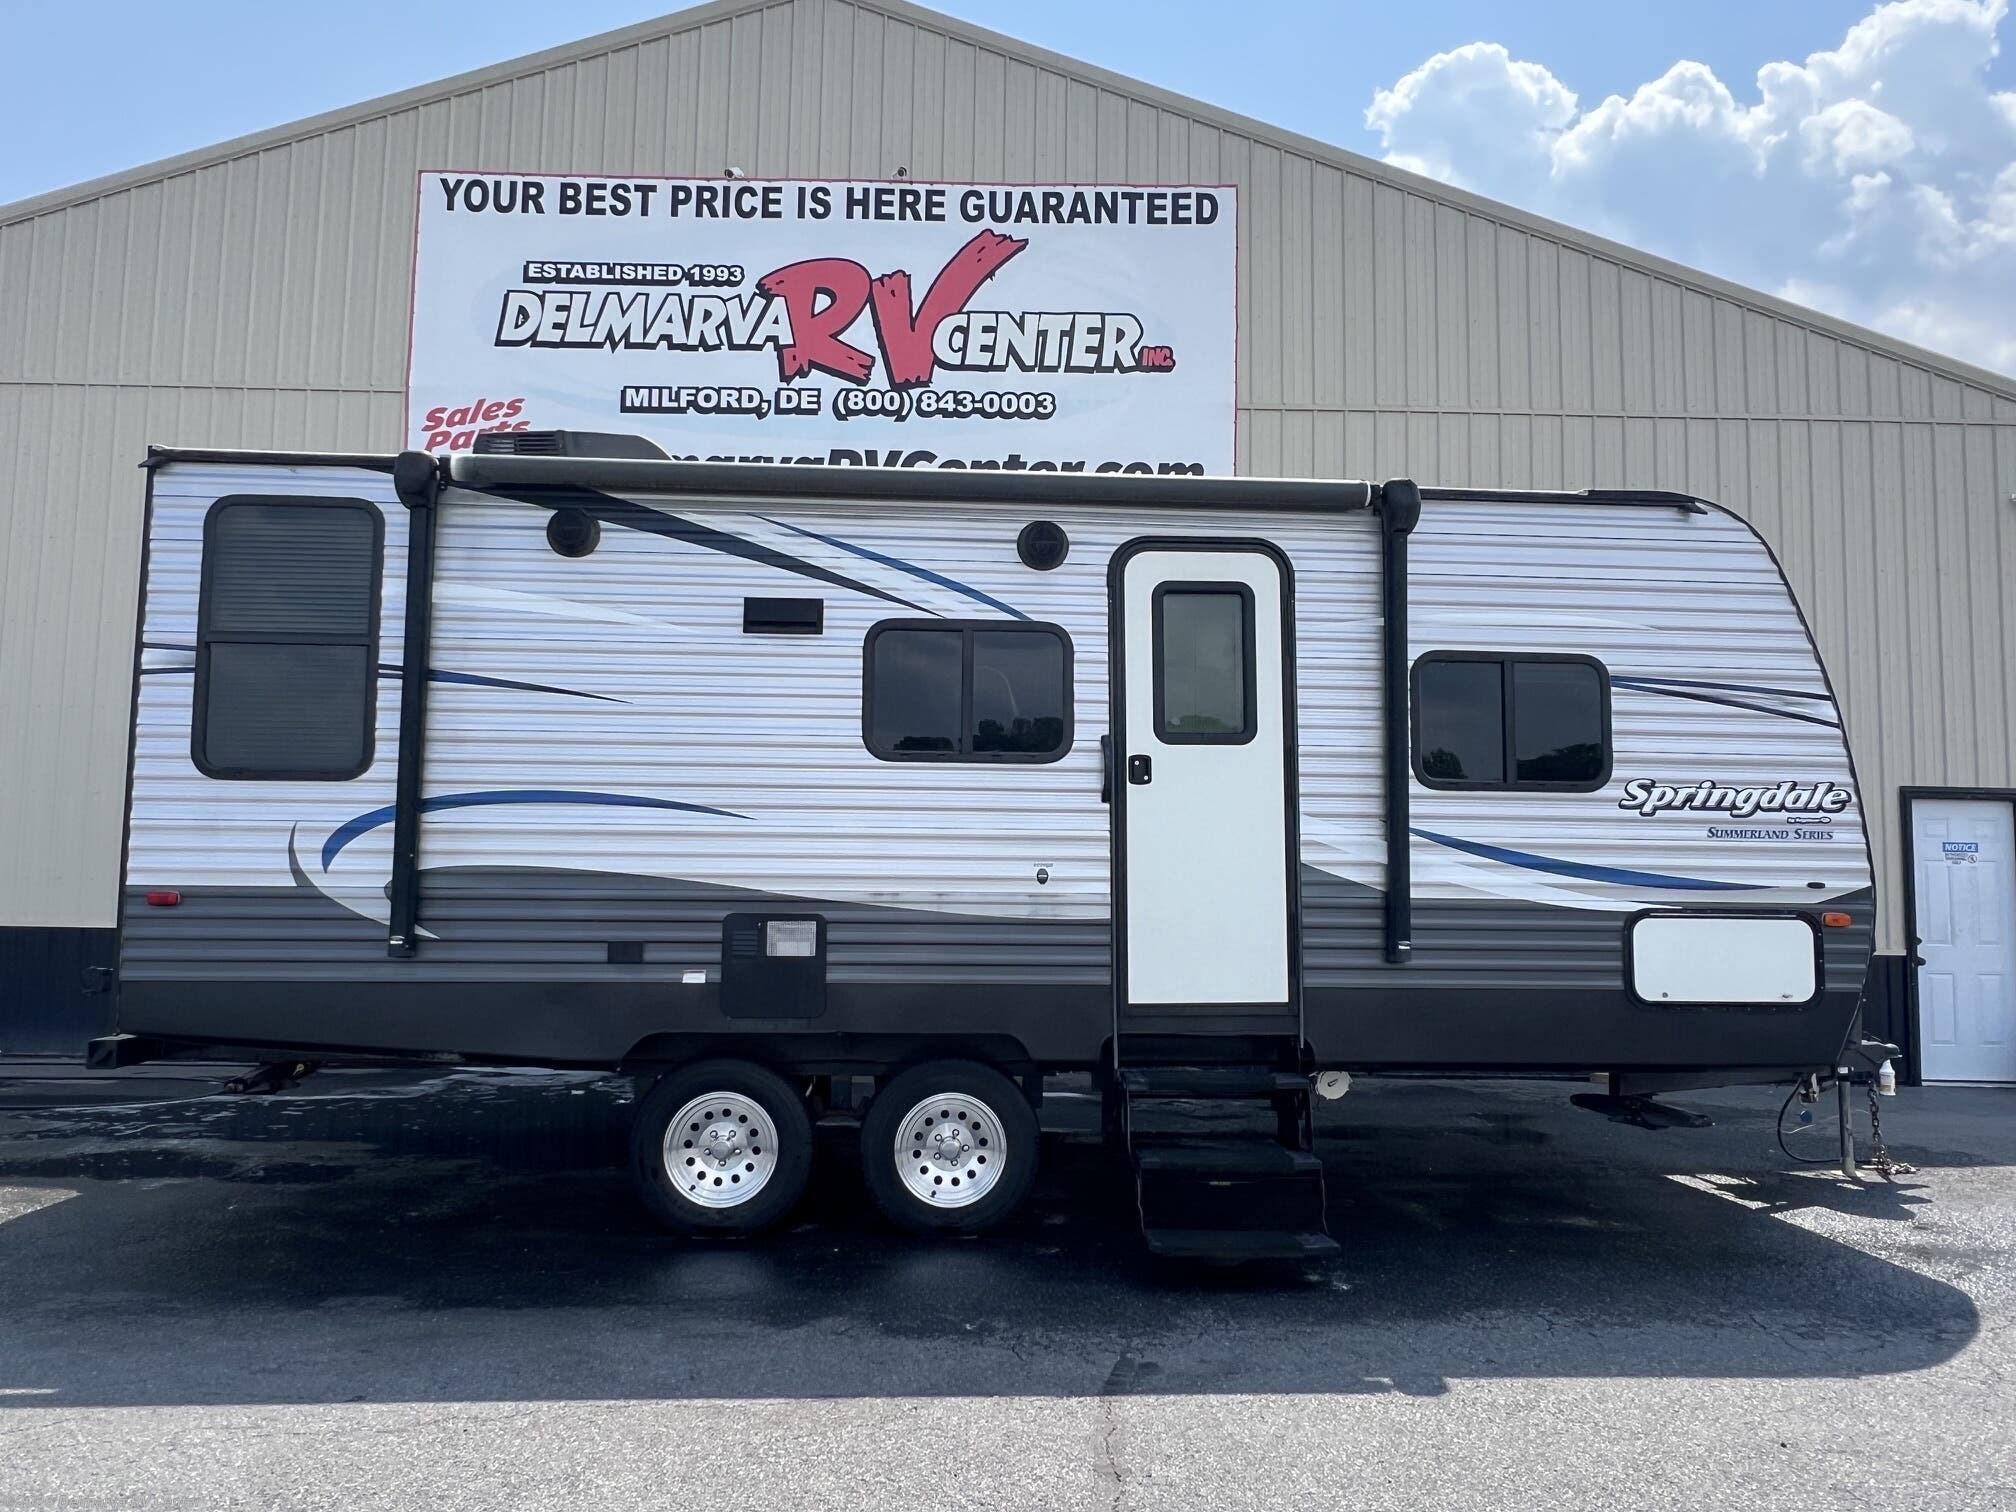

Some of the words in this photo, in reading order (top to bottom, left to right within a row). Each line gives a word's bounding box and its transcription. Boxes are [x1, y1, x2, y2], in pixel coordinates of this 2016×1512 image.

[440, 178, 545, 215] YOUR
[558, 182, 658, 217] BEST
[670, 185, 783, 219] PRICE
[797, 186, 832, 220] IS
[846, 187, 947, 223] HERE
[959, 190, 1219, 225] GUARANTEED
[526, 263, 684, 281] ESTABLISHED
[688, 265, 743, 283] 1993
[495, 290, 796, 352] DELMARVA
[756, 229, 1029, 391] RV
[932, 310, 1144, 374] CENTER
[421, 398, 526, 432] Sales
[623, 387, 771, 415] MILFORD,
[777, 389, 820, 411] DE
[836, 390, 912, 420] (800)
[919, 391, 1055, 416] 843-0003
[1618, 778, 1852, 819] Springdale
[1706, 826, 1789, 840] SUMMERLAND
[1793, 828, 1834, 840] SERIES
[1944, 843, 1977, 852] NOTICE
